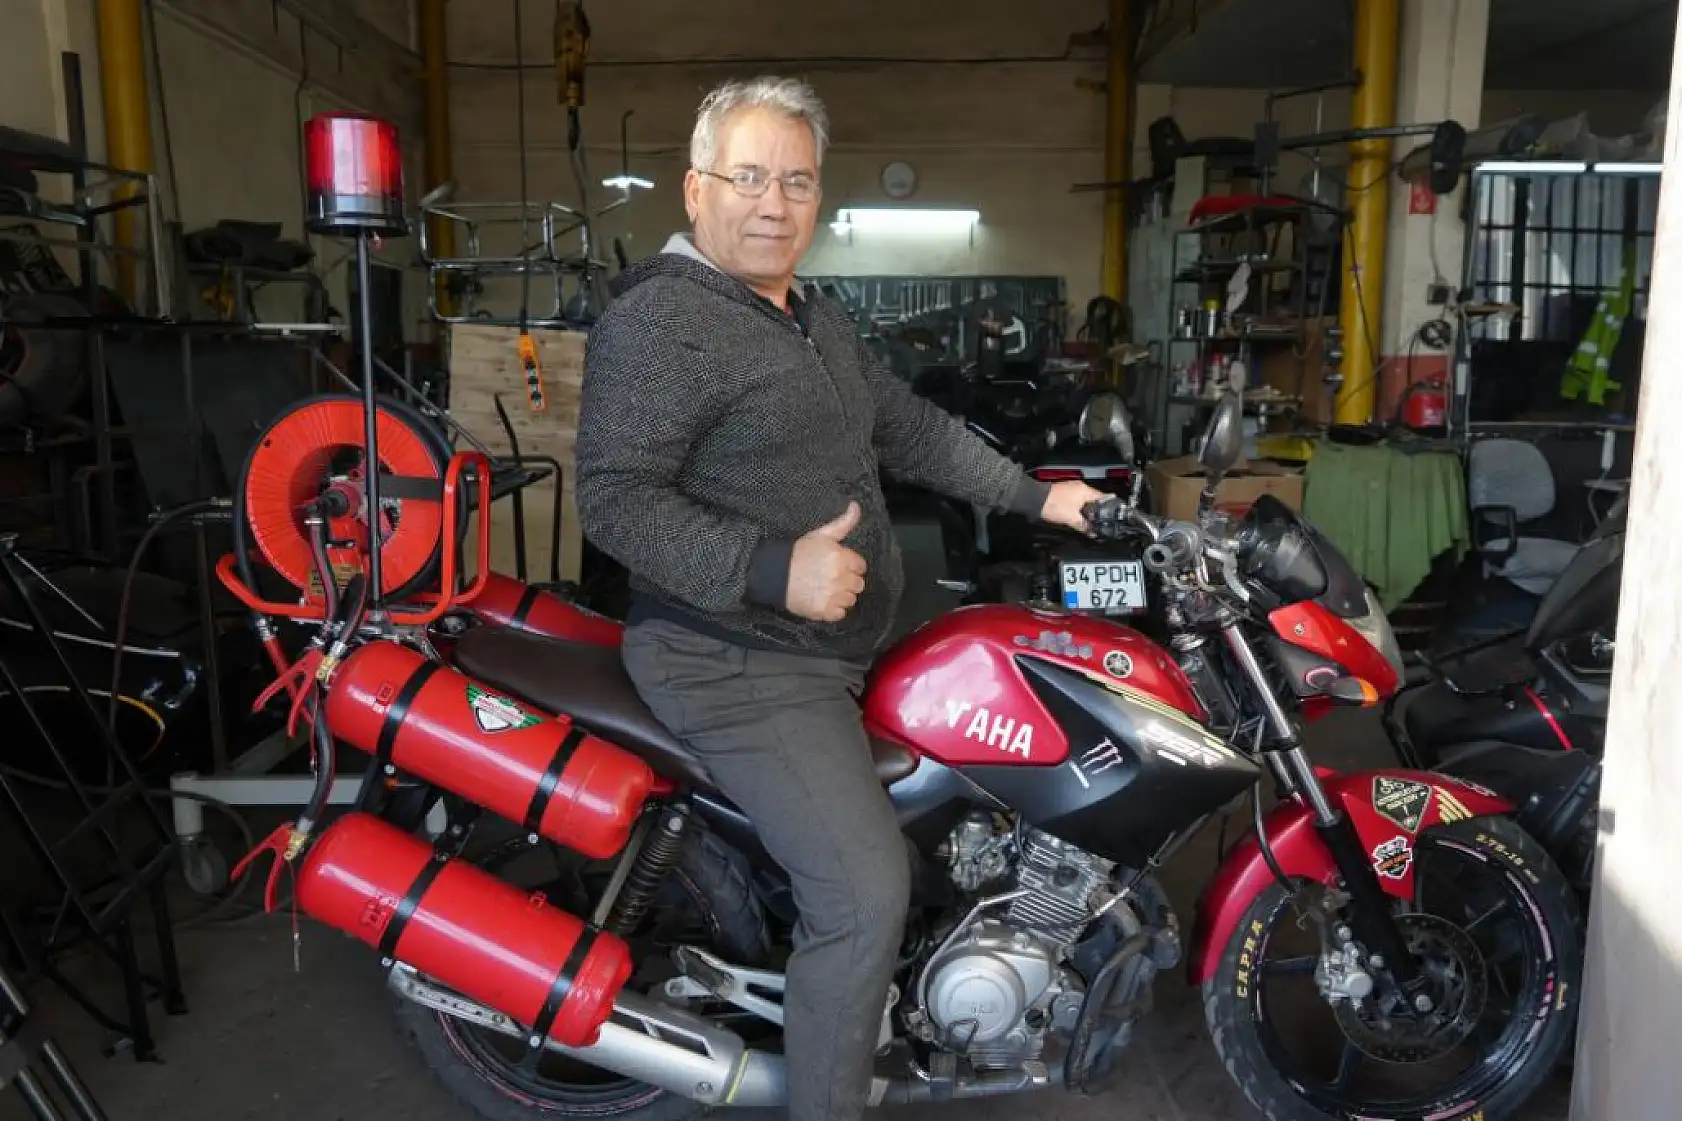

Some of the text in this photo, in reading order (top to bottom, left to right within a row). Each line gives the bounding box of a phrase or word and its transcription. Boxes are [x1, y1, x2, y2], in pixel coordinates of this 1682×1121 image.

[1065, 565, 1138, 585] 34 PDH
[1091, 588, 1129, 607] 672
